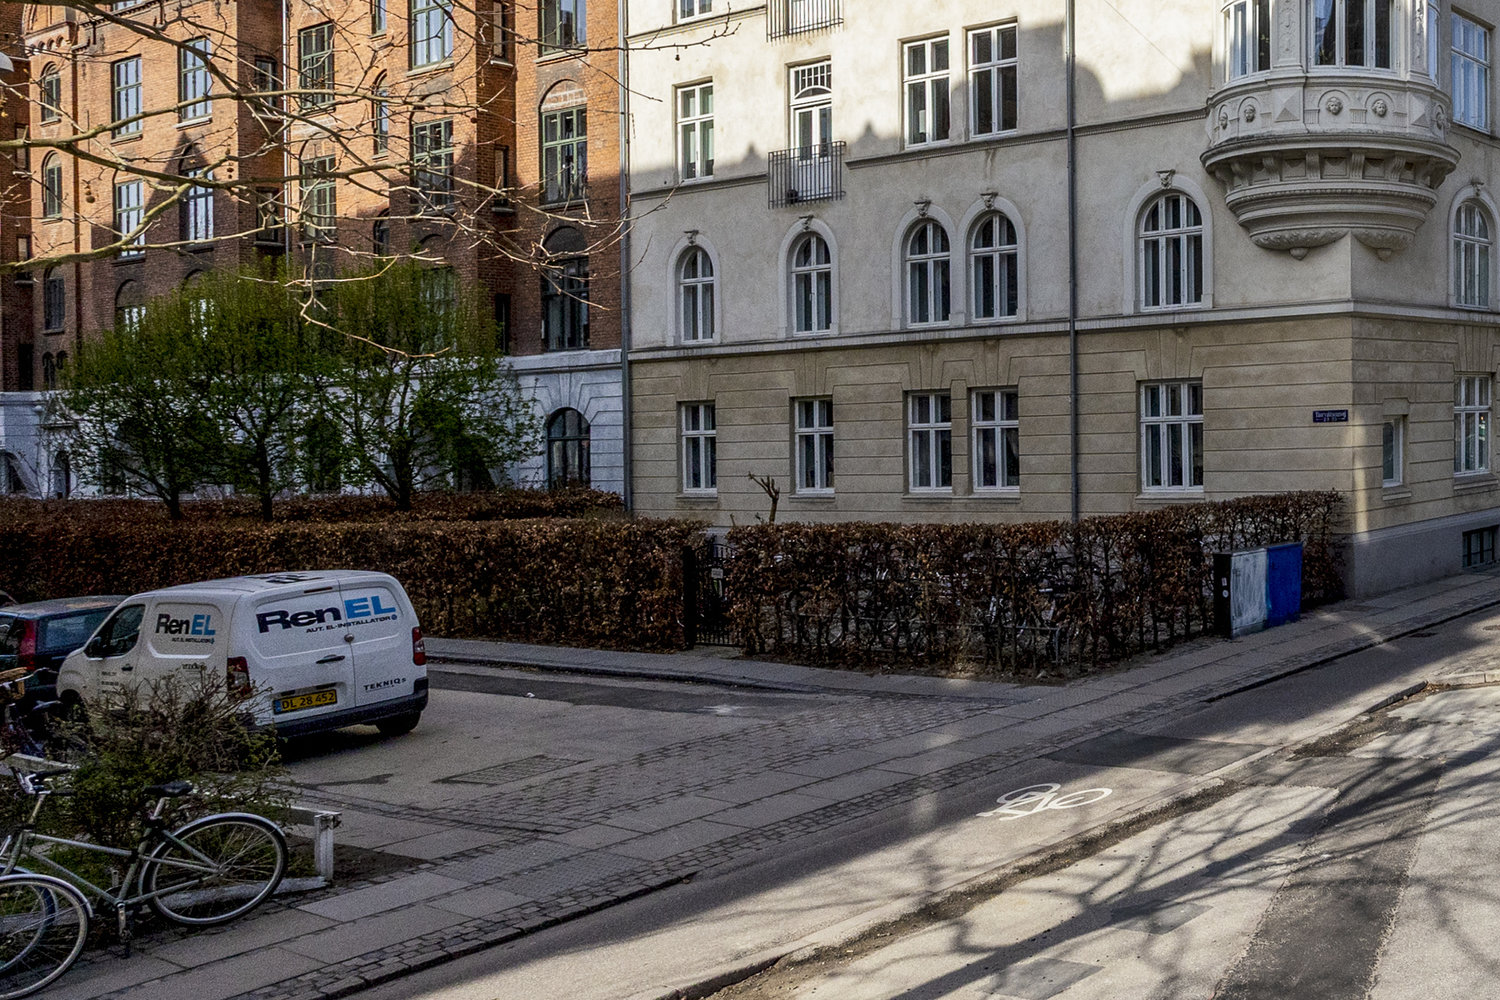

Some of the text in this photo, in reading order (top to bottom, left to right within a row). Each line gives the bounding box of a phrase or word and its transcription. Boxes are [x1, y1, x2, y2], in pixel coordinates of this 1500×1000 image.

[306, 623, 325, 633] AUT.
[281, 692, 335, 710] DL 28 452
